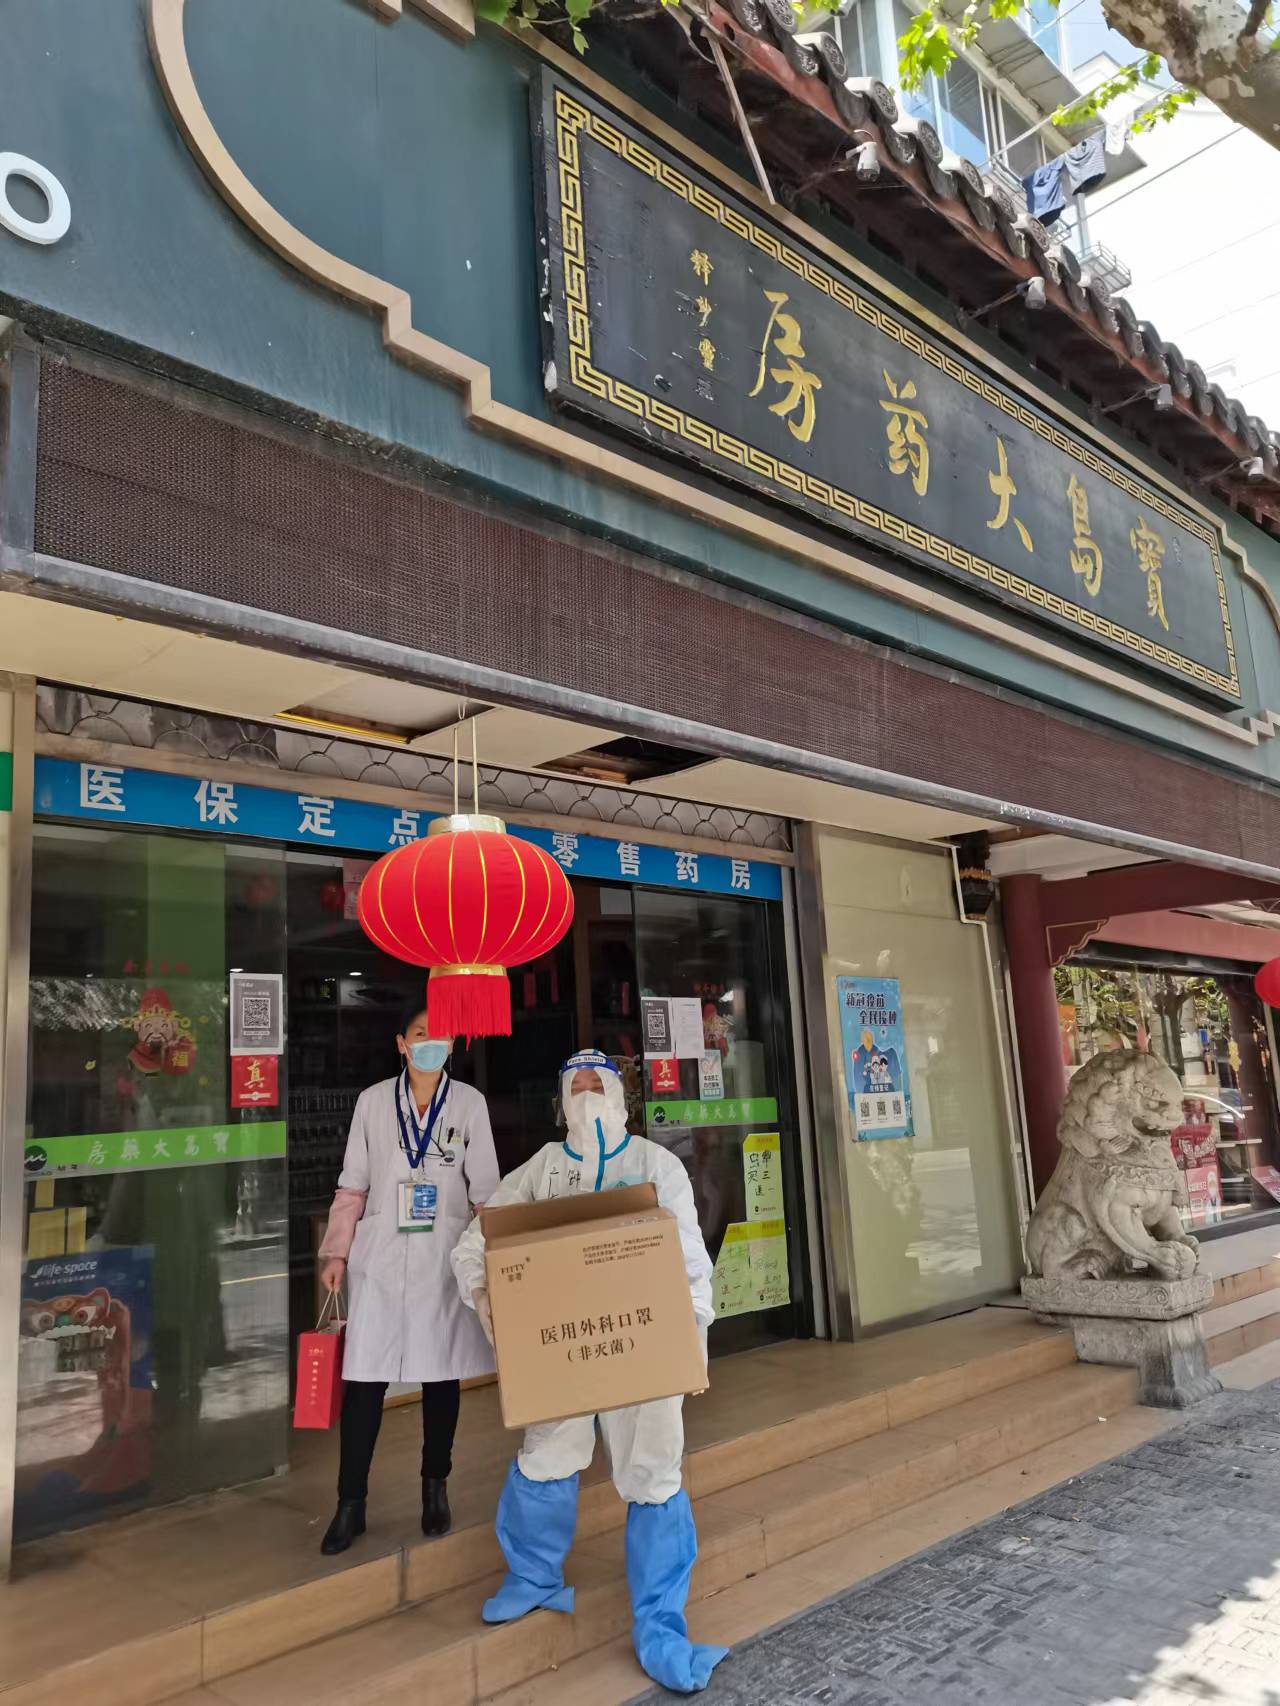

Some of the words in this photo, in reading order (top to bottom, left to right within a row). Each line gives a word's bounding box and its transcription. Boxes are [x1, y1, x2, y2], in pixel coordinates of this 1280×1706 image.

[551, 830, 751, 890] 零售药房
[845, 992, 885, 1008] 新冠疫苗
[858, 1009, 897, 1025] 全民接种
[244, 1059, 265, 1089] 真
[501, 1263, 525, 1275] FITTY
[541, 1307, 654, 1346] 医用外科口罩
